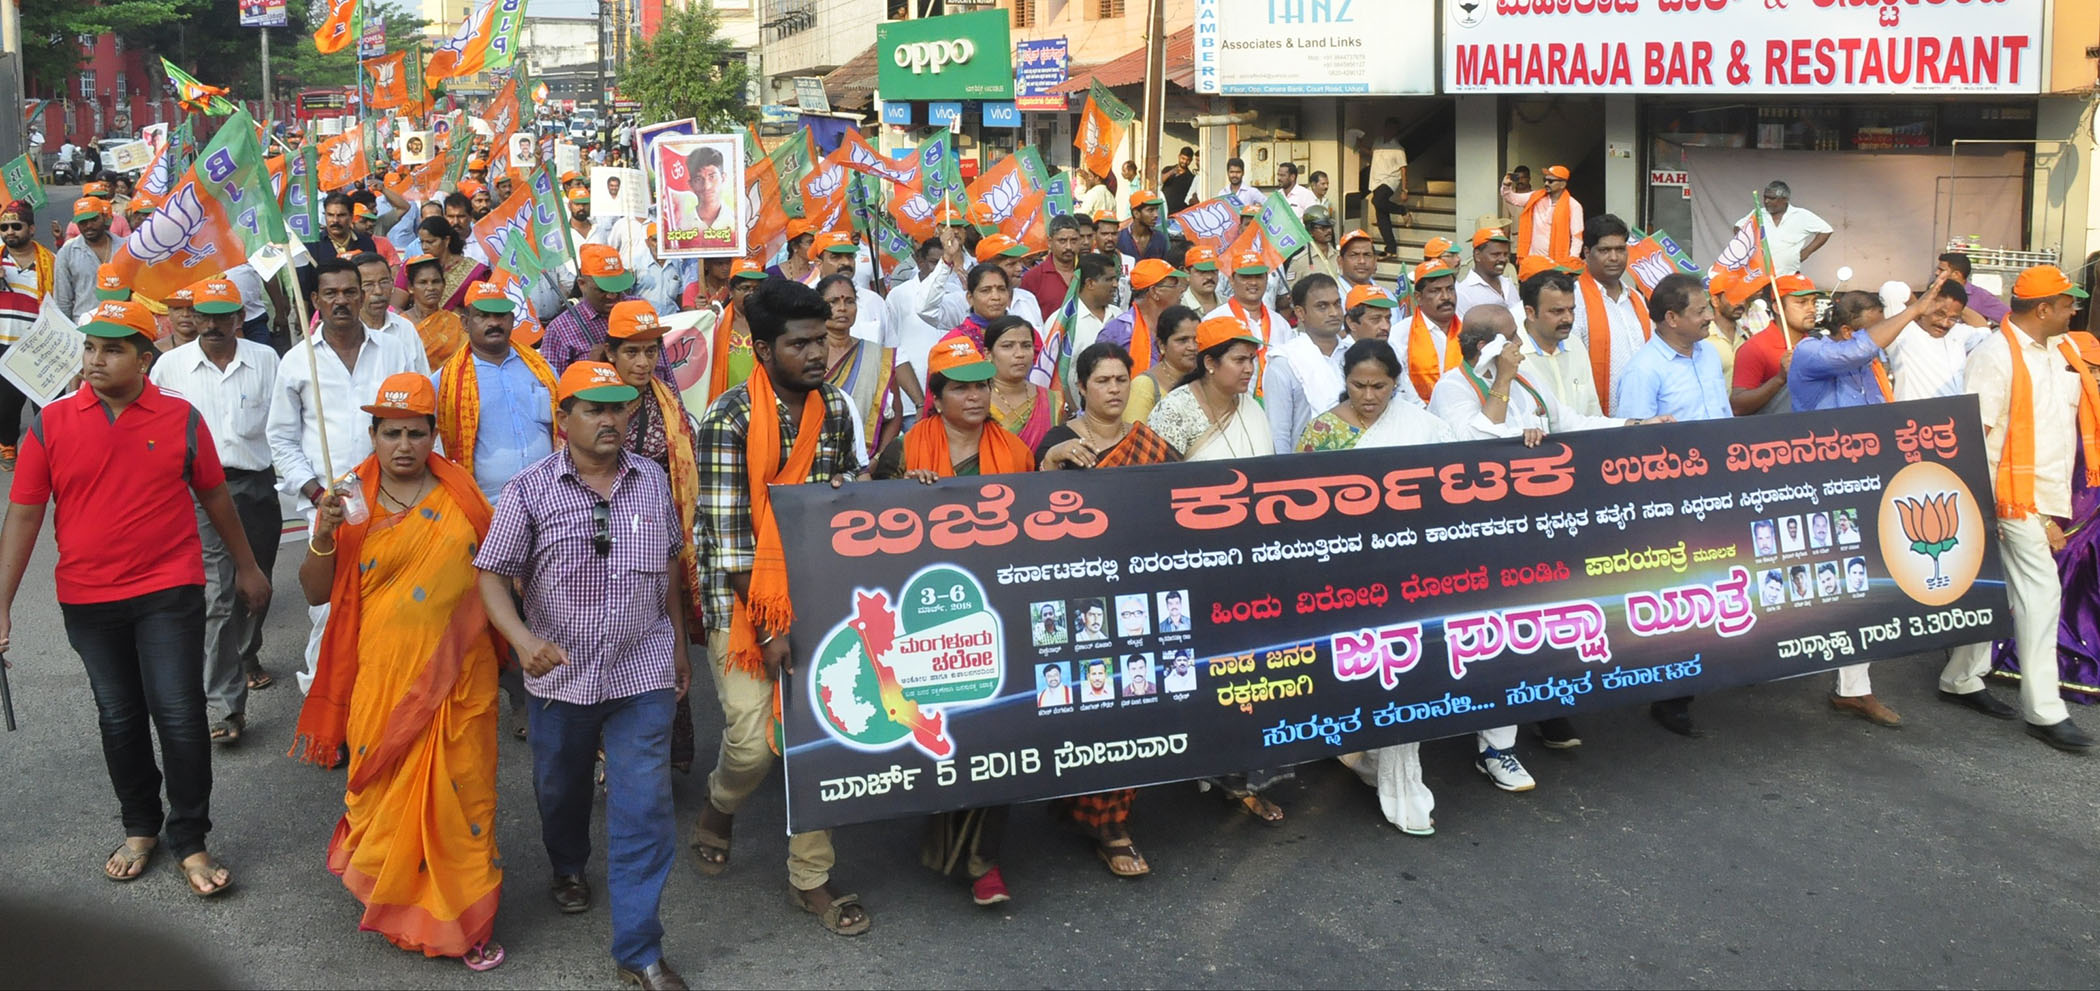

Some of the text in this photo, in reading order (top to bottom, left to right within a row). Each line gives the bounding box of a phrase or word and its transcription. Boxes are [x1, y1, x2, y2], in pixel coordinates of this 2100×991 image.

[1221, 36, 1362, 50] Associates & Land Links
[1456, 36, 2028, 85] MAHARAJA BAR & RESTAURANT
[830, 416, 1959, 557] ಬಿಜೆಪಿ ಕರ್ನಾಟಕ ಉಡುಪಿ ವಿಧಾನಸಭಾ ಕ್ಷೇತ್ರ
[997, 557, 1120, 584] ಕರ್ನಾಟಕದಲ್ಲಿ
[1128, 548, 1243, 574] ನಿರಂತರವಾಗಿ
[1252, 533, 1363, 563] ನಡೆಯುತ್ತಿರುವ
[1371, 527, 1418, 549] ಹಿಂದು
[1425, 515, 1529, 542] ಕಾರ್ಯಕರ್ತರ
[1642, 501, 1675, 519] ಸದಾ
[1823, 475, 1882, 493] ಸರಕಾರದ
[1211, 540, 1737, 624] ಹಿಂದು ವಿರೋಧಿ ಧೋರಣೆ ಖಂಡಿಸಿ ಪಾದಯಾತ್ರೆ ಮೂಲಕ
[950, 601, 972, 611] 2018
[1330, 565, 1757, 690] ಜನ ಸುರಕ್ಷಾ ಯಾತ್ರೆ
[900, 630, 993, 654] ಮಂಗಳೂರು
[932, 649, 993, 672] ಚಲೋ
[1209, 641, 1317, 677] ನಾಡ ಜನರ
[1778, 629, 1855, 662] ಮಧ್ಯಾಹ್ನ
[1860, 618, 1901, 650] ಗಂಟೆ
[1217, 674, 1314, 715] ರಕ್ಷಣೆಗಾಗಿ
[1262, 705, 1362, 748] ಸುರಕ್ಷಿತ
[1506, 670, 1592, 706] ಸುರಕ್ಷಿತ
[1601, 653, 1702, 691] ಕರ್ನಾಟಕ
[820, 733, 1189, 803] ಮಾರ್ಚ್ 5 2018 ಸೋಮವಾರ
